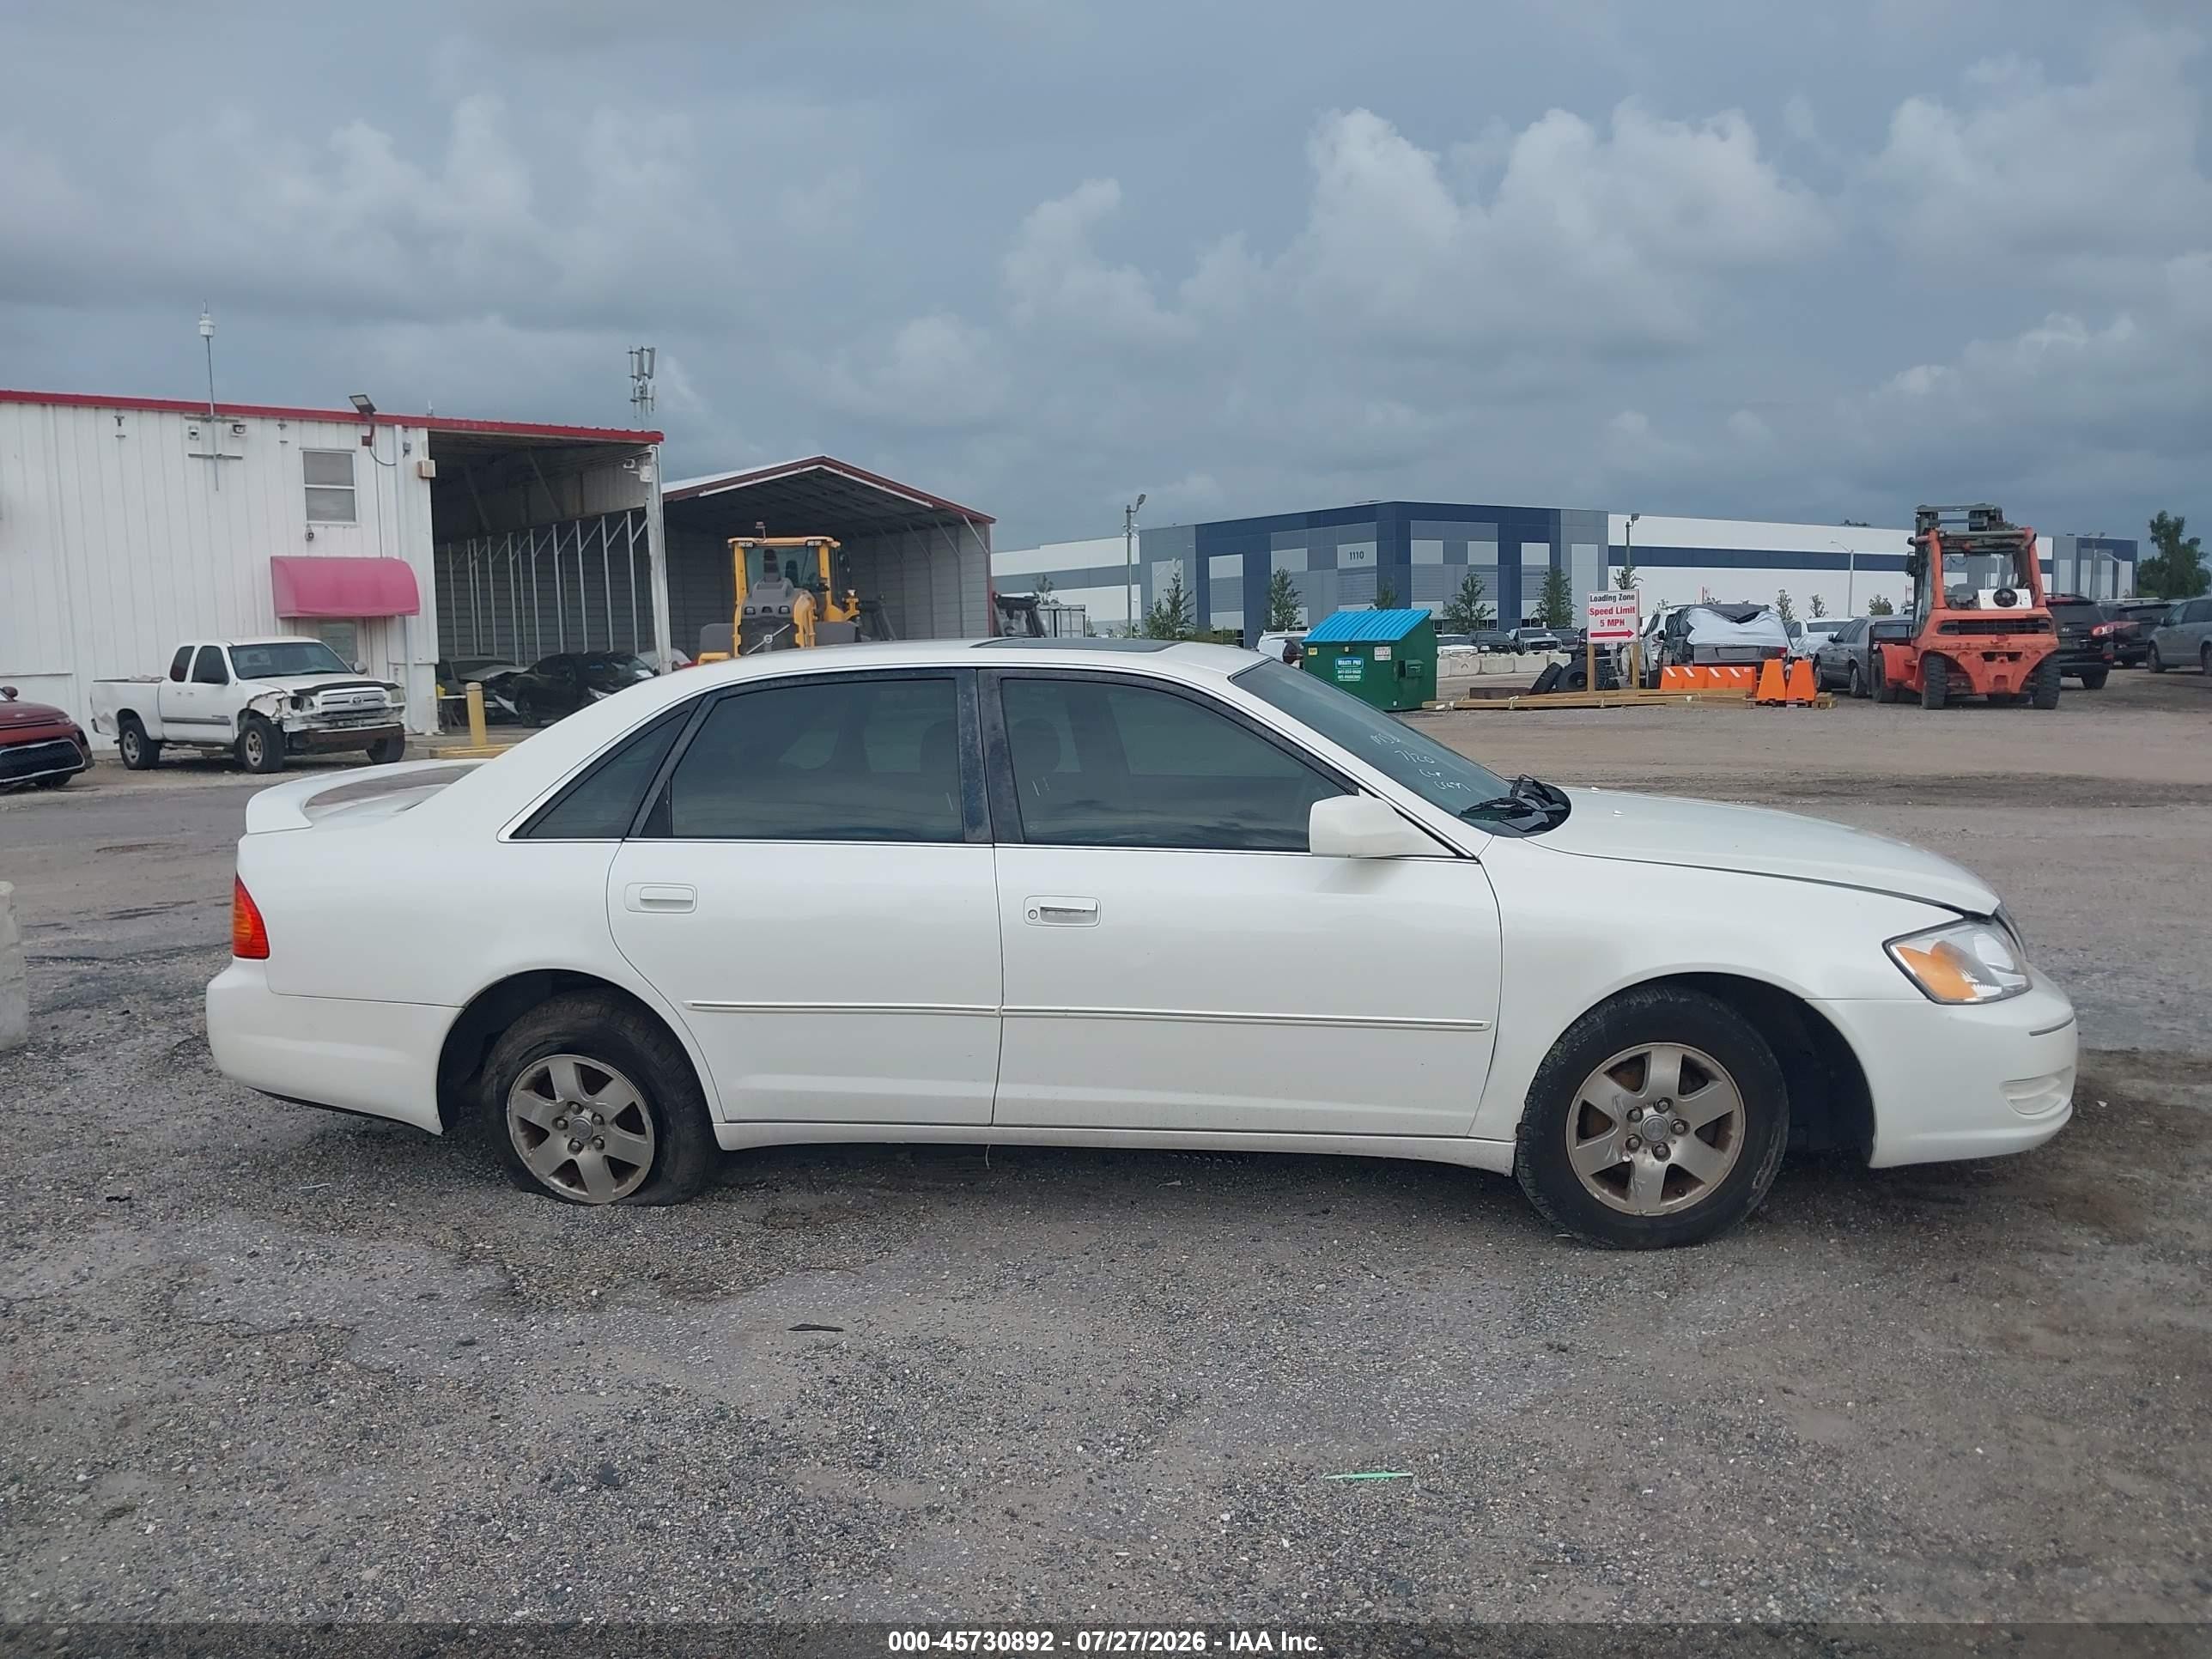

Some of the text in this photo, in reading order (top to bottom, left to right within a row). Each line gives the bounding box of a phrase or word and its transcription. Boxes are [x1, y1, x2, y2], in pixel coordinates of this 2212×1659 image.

[1350, 551, 1364, 560] 1110
[1589, 593, 1616, 603] Loading
[1589, 606, 1636, 617] Speed Limit
[1607, 618, 1625, 627] MPH
